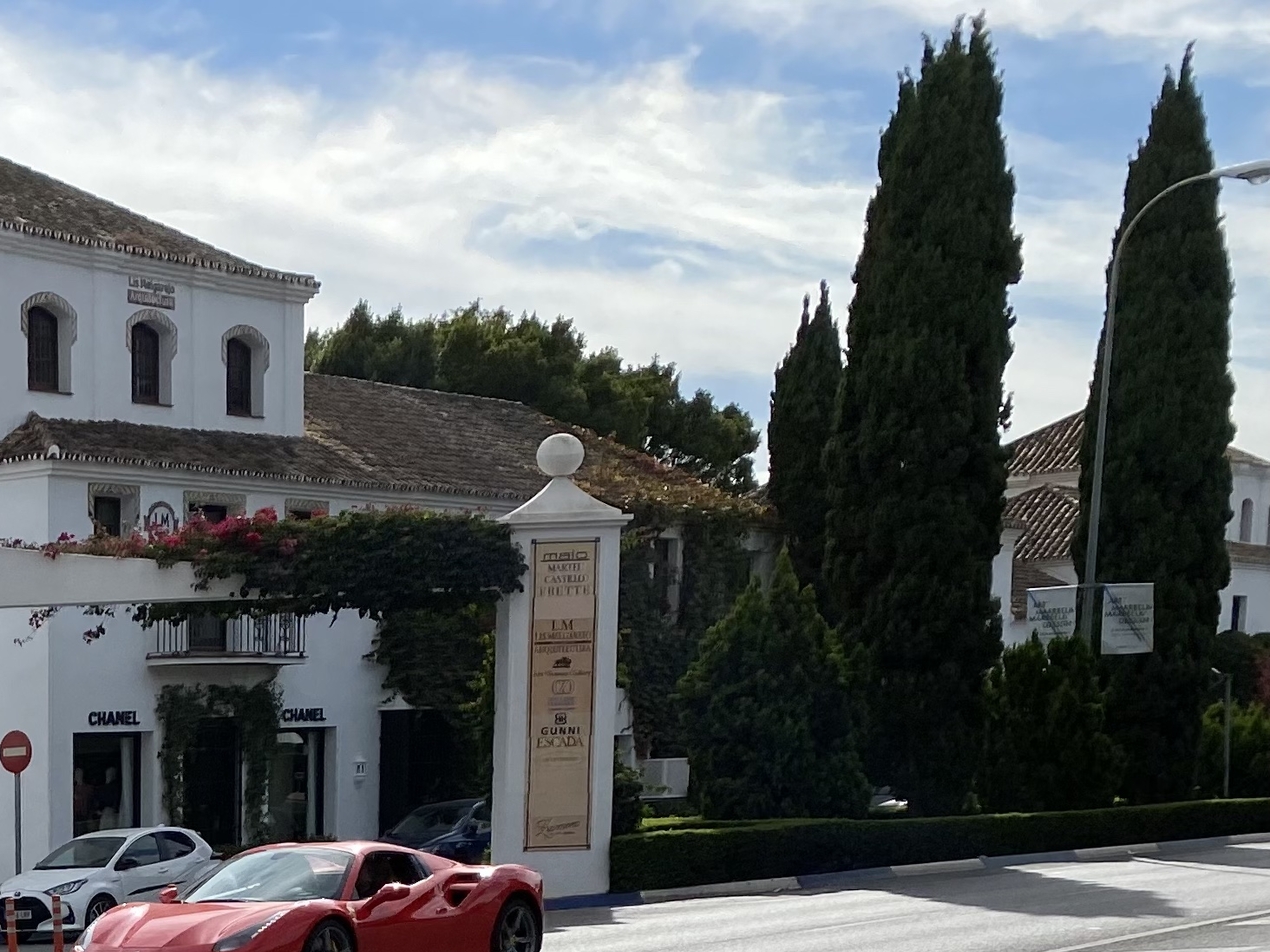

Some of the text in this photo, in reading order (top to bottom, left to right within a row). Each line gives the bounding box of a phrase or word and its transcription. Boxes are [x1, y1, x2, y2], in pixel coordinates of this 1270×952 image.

[88, 710, 140, 726] CHANEL
[282, 708, 327, 722] CHANEL
[541, 727, 580, 735] GUNNI
[536, 737, 584, 748] ESCADA
